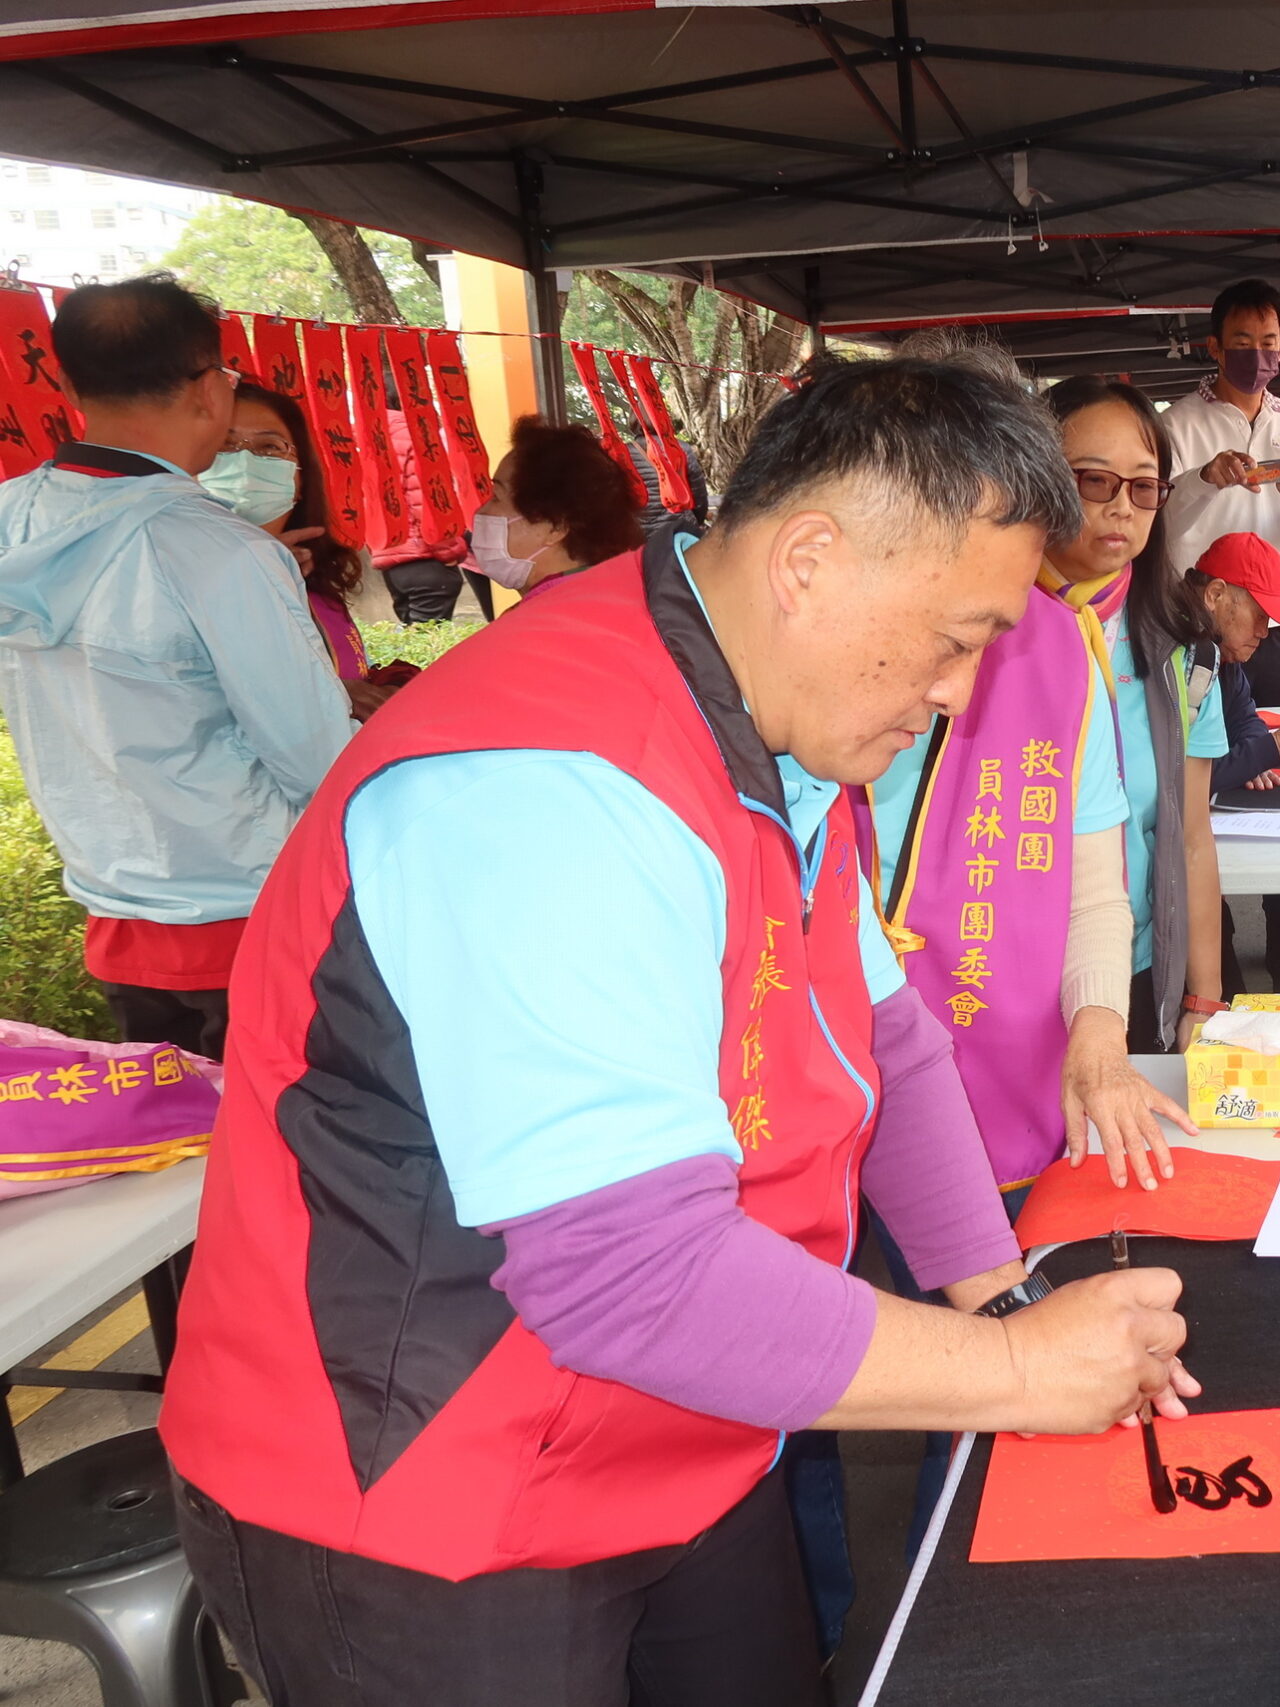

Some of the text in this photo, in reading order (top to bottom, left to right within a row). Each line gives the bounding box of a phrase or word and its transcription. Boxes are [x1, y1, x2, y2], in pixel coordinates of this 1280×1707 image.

[1016, 738, 1065, 872] 救國團
[944, 759, 1006, 1027] 員林市團委會
[0, 1048, 202, 1105] 員林市團
[1214, 1093, 1259, 1120] 舒滴
